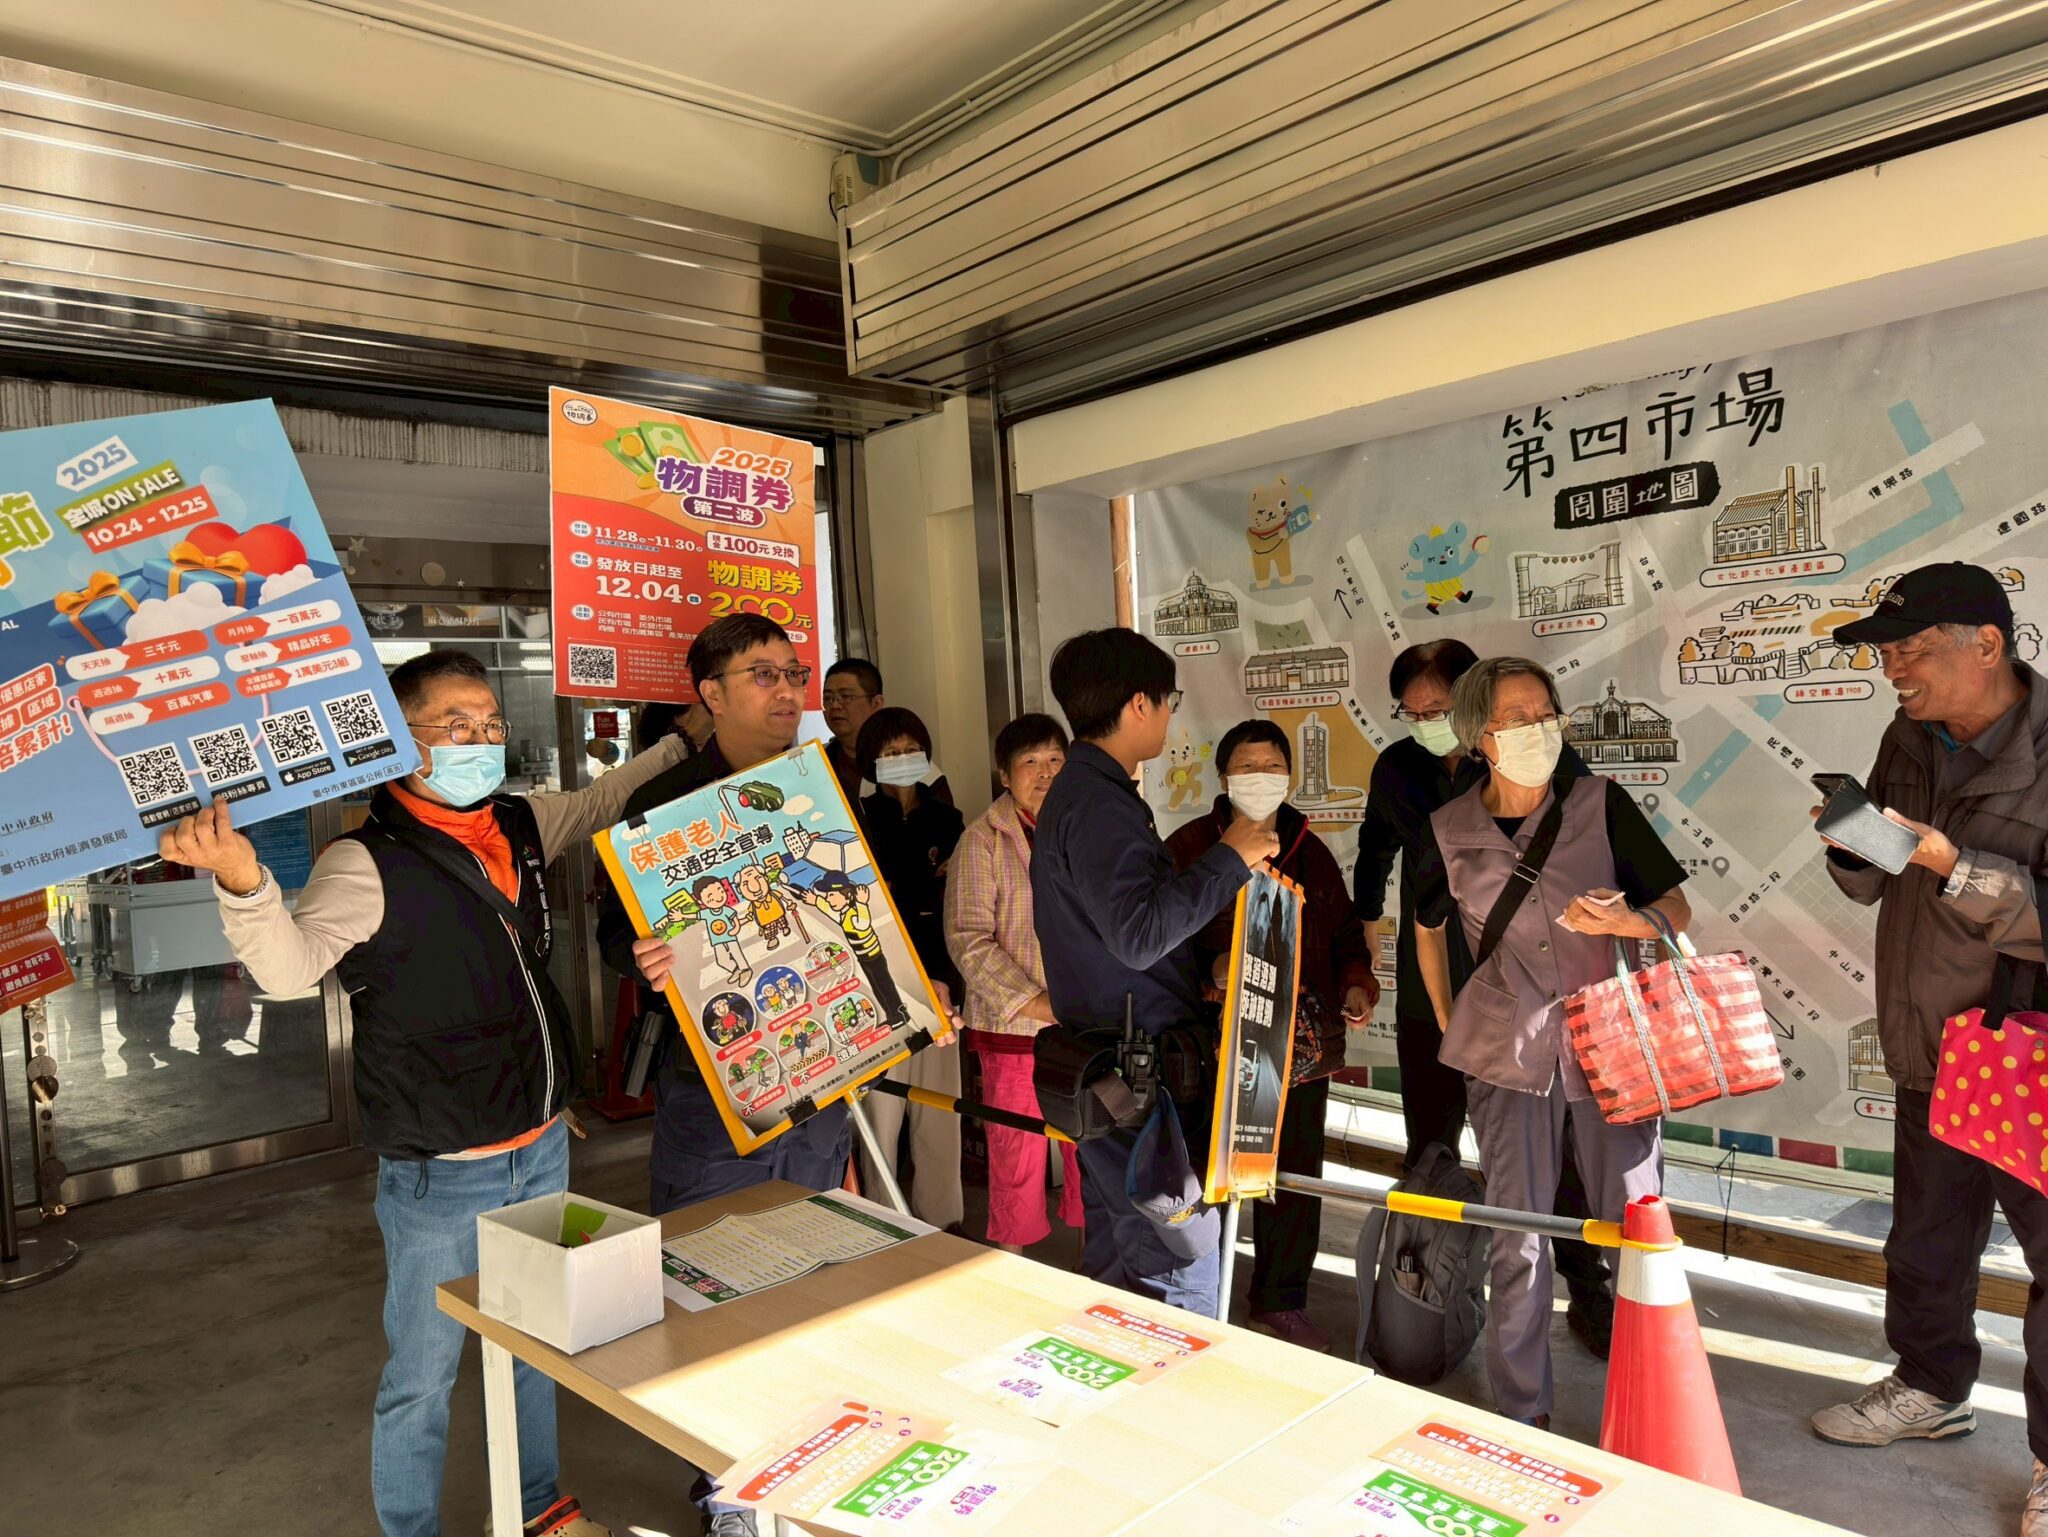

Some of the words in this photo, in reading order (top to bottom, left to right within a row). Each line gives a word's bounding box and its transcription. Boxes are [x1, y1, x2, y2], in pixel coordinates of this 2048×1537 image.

[1503, 367, 1785, 498] 第四市場
[62, 443, 127, 486] 2025
[715, 449, 790, 477] 2025
[138, 468, 180, 498] SALE
[657, 457, 792, 510] 物調券
[1569, 468, 1698, 521] 周圍地圖
[1868, 467, 1913, 499] 復興路
[88, 518, 143, 547] 10.24
[159, 496, 209, 522] 12.25
[694, 500, 754, 523] 第二波
[1997, 502, 2047, 536] 建國路
[597, 557, 683, 580] 發放日起至
[707, 560, 802, 595] 物調券
[1640, 556, 1663, 592] 台中路
[1717, 560, 1825, 581] 文化部文化資產園區
[596, 575, 683, 604] 12.04
[228, 625, 255, 638] 月月抽
[277, 608, 322, 627] 一百萬元
[143, 640, 181, 658] 三千元
[287, 634, 331, 653] 精品好宅
[80, 657, 111, 672] 天天抽
[154, 667, 193, 684] 十萬元
[296, 656, 349, 679] 1萬美元3組
[1, 671, 47, 705] 優惠店家
[92, 685, 124, 699] 週週抽
[165, 692, 214, 711] 百萬汽車
[28, 696, 56, 718] 區域
[104, 712, 134, 727] 隔週抽
[357, 750, 379, 762] Google
[380, 746, 394, 758] play
[297, 769, 311, 780] App
[312, 764, 332, 777] Store
[312, 770, 384, 799] 臺中市東區區公所
[631, 811, 743, 873] 保護老人
[1681, 818, 1714, 848] 中山路
[0, 829, 128, 876] 臺中市政府經濟發展局
[661, 824, 774, 887] 交通安全宣導
[1729, 871, 1782, 923] 自由路二段
[1828, 950, 1866, 983] 中山路
[1748, 956, 1820, 1021] 台灣大道一段
[799, 1071, 810, 1084] 不
[744, 1103, 756, 1117] 不
[1061, 1365, 1113, 1387] 200
[912, 1450, 963, 1484] 200
